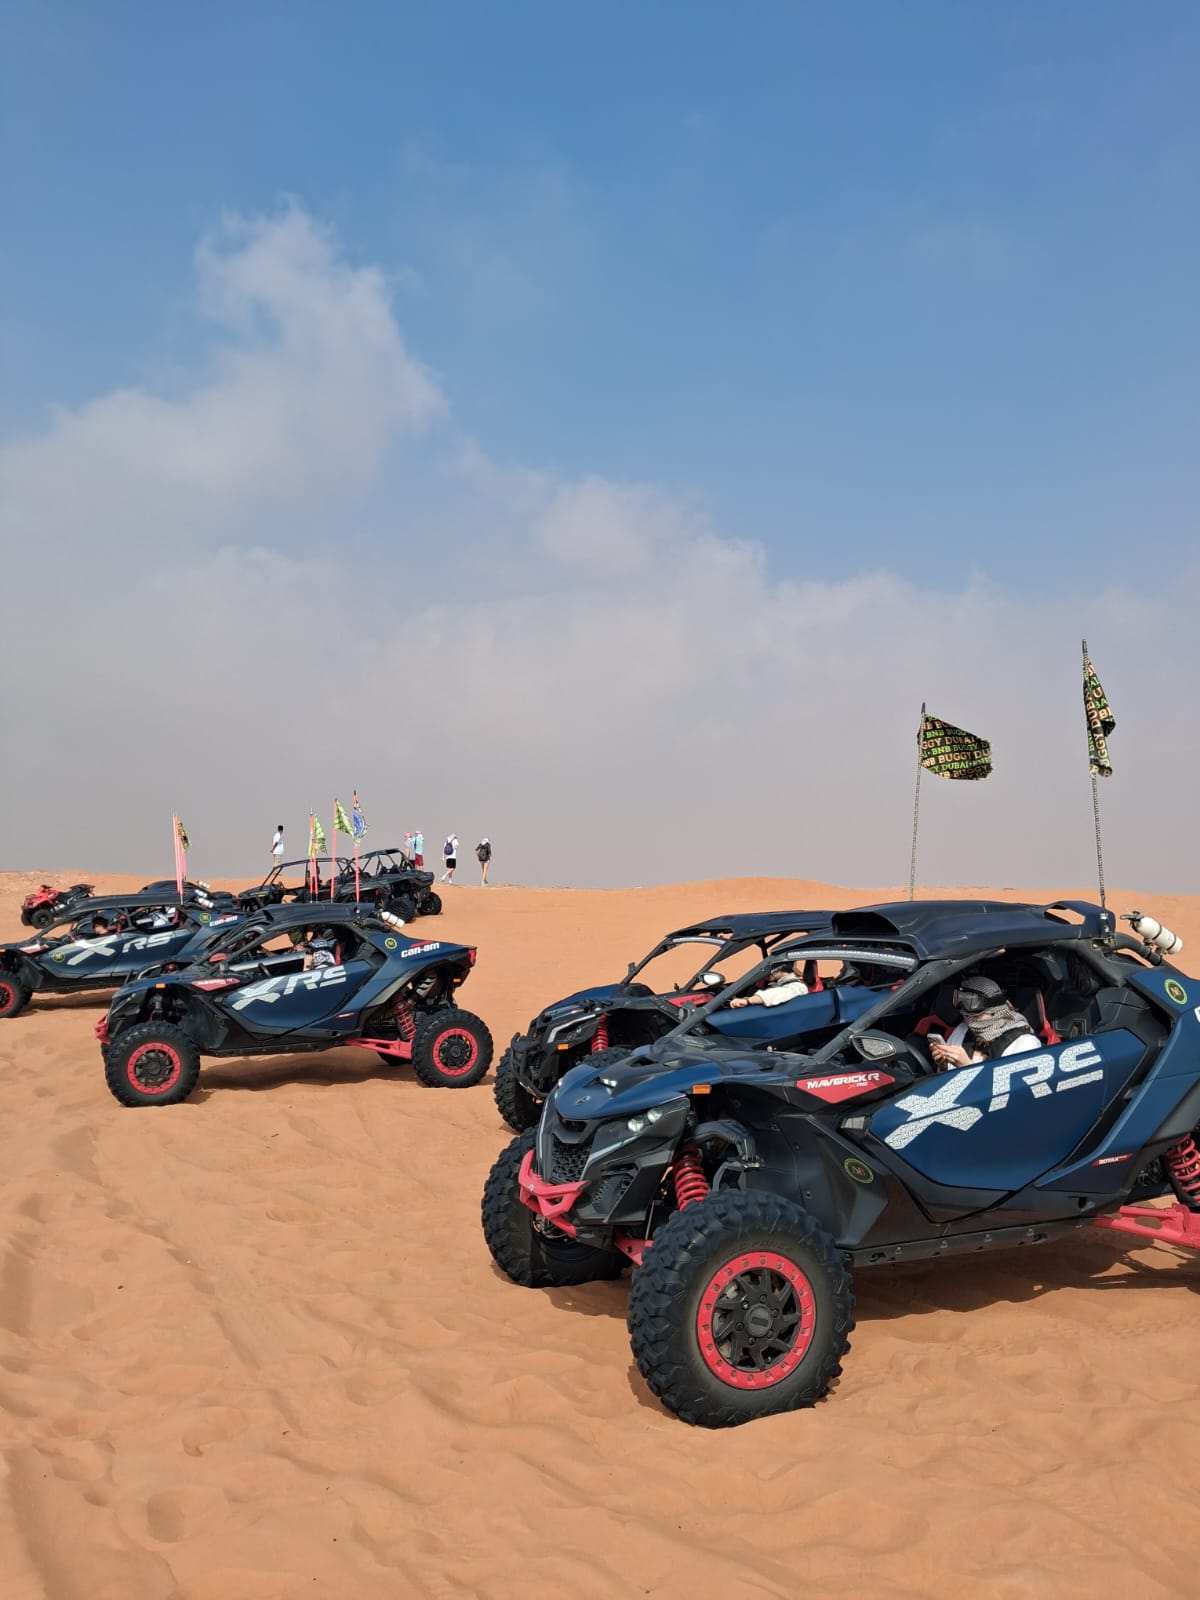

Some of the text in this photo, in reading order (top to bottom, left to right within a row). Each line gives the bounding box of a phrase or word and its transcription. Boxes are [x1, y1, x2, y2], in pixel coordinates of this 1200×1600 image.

[401, 942, 440, 958] can-am
[231, 964, 347, 1011] XRS
[806, 1072, 880, 1089] MAVERICK R
[884, 1041, 1104, 1150] XRS
